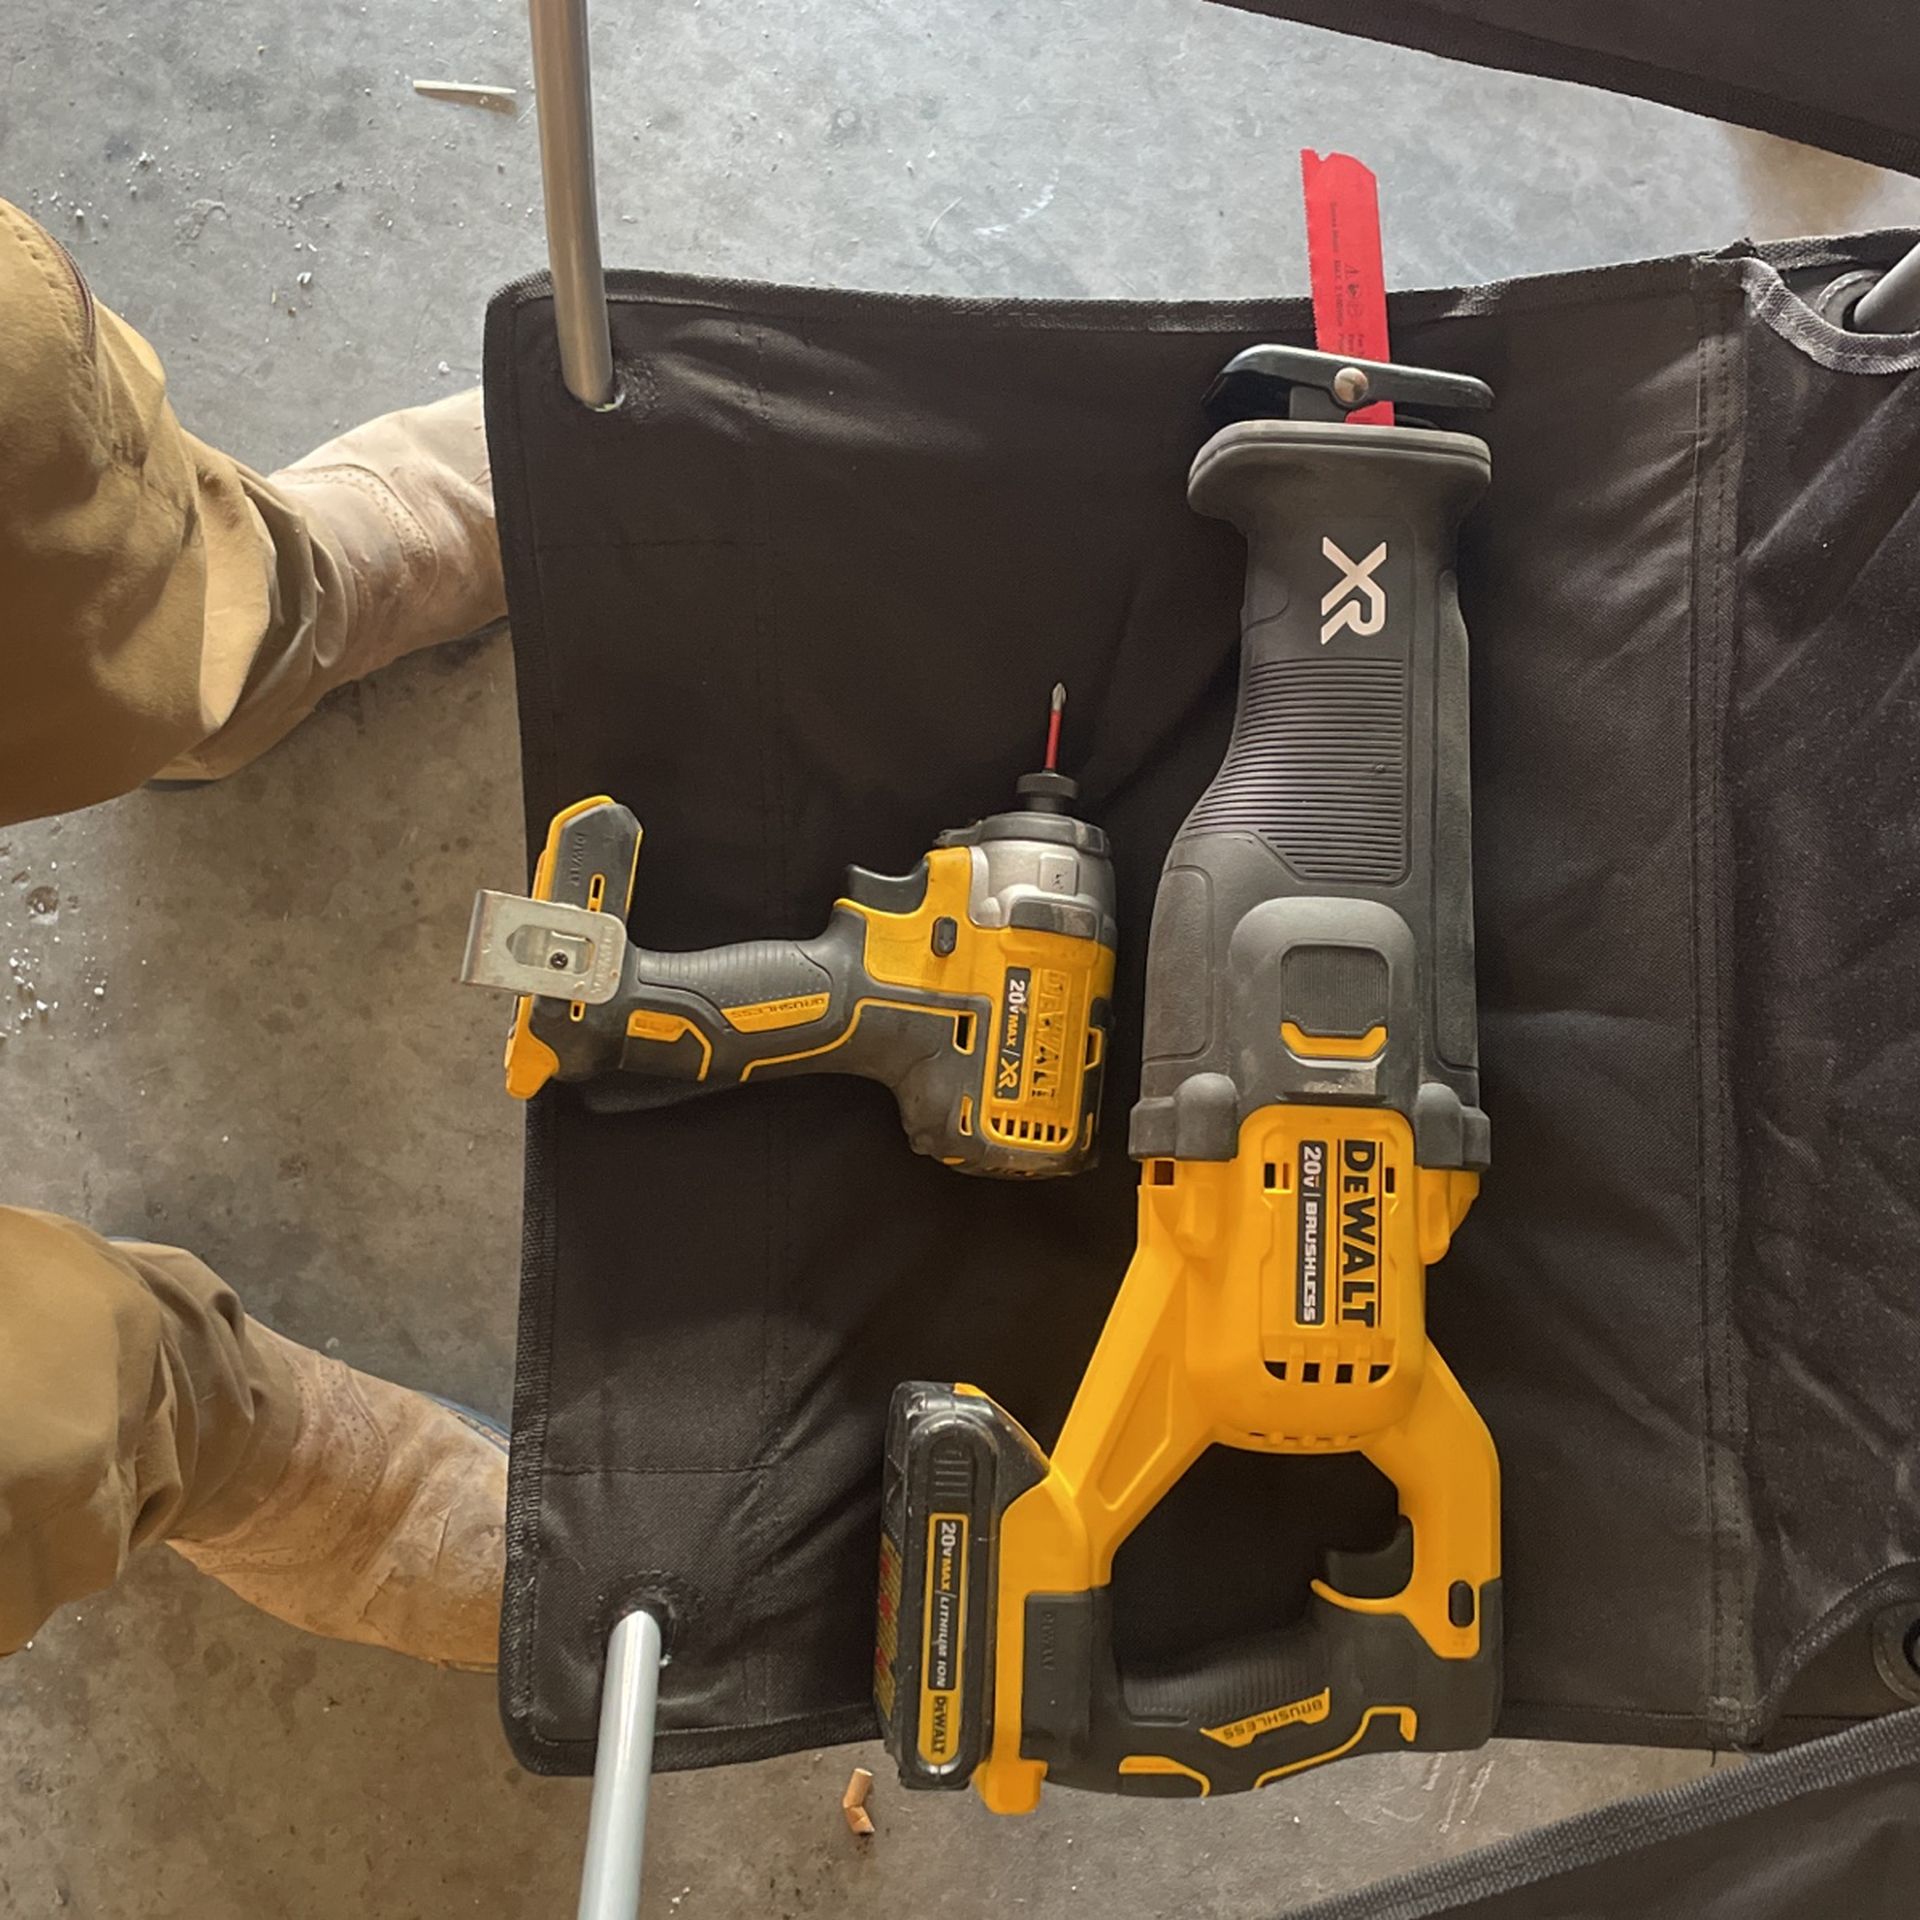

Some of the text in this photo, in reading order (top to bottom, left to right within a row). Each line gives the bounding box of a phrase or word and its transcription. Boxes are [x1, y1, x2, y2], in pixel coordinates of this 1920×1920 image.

[1321, 536, 1387, 645] XR
[998, 1057, 1020, 1089] XR
[1303, 1201, 1318, 1322] BRUSHLESS
[1342, 1140, 1376, 1328] DEWALT
[938, 1597, 950, 1657] LITHIUM
[936, 1660, 948, 1687] ION
[932, 1695, 948, 1754] DEWALT
[1222, 1699, 1324, 1741] BRUSHLESS
